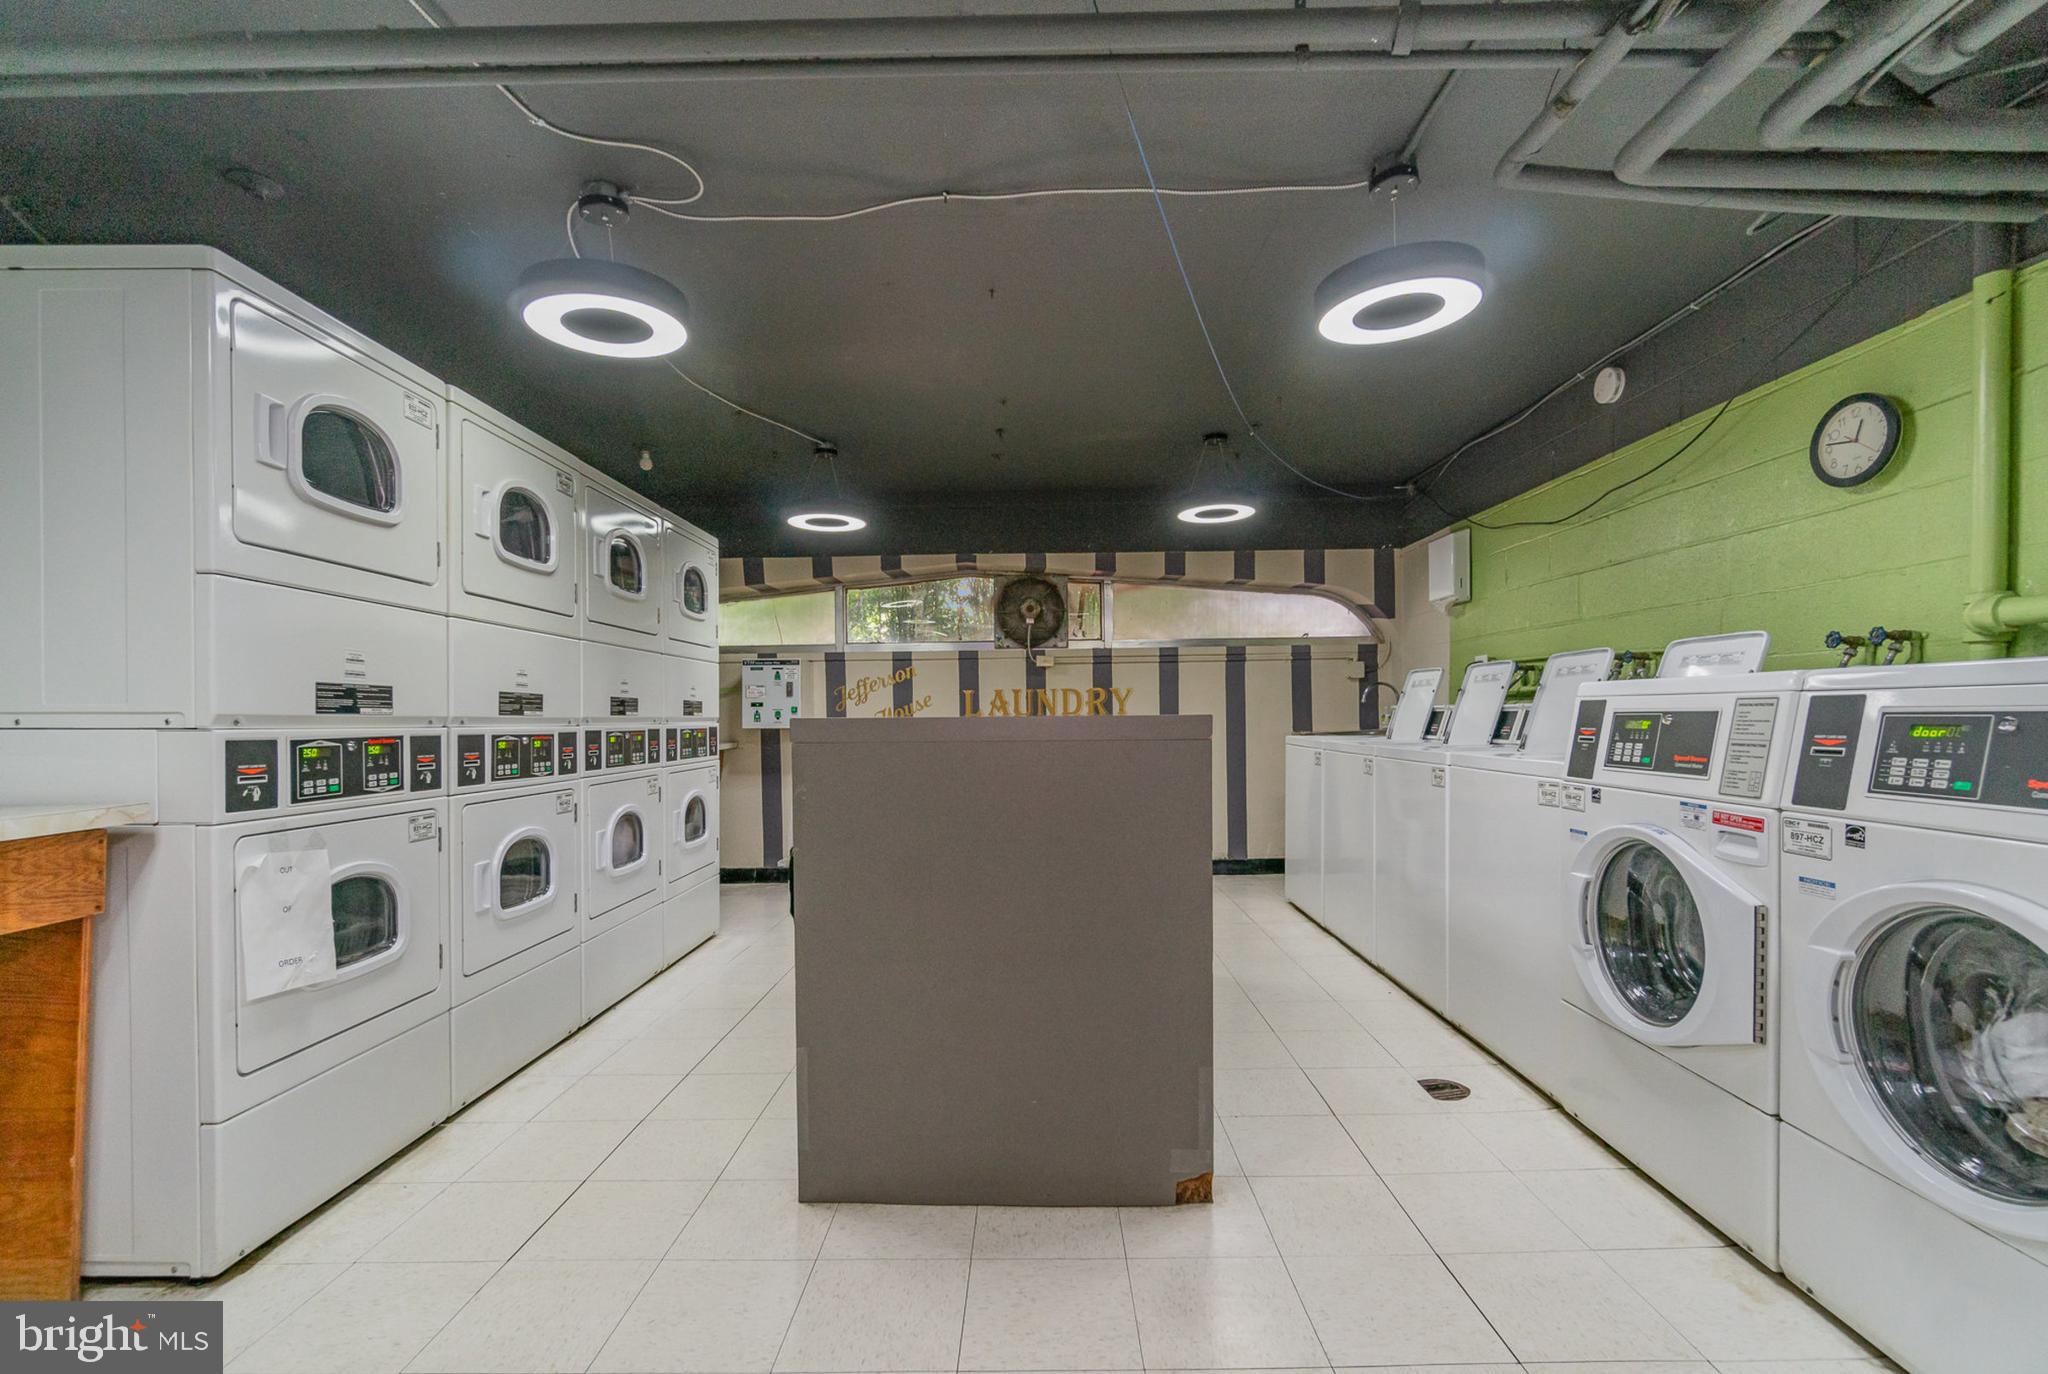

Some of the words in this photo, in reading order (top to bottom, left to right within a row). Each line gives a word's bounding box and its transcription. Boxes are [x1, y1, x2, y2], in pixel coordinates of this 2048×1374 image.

[834, 666, 918, 712] Jefferson
[962, 687, 1134, 717] LAUNDRY
[279, 865, 293, 874] OUT
[282, 904, 292, 913] OF
[278, 956, 303, 968] ORDER
